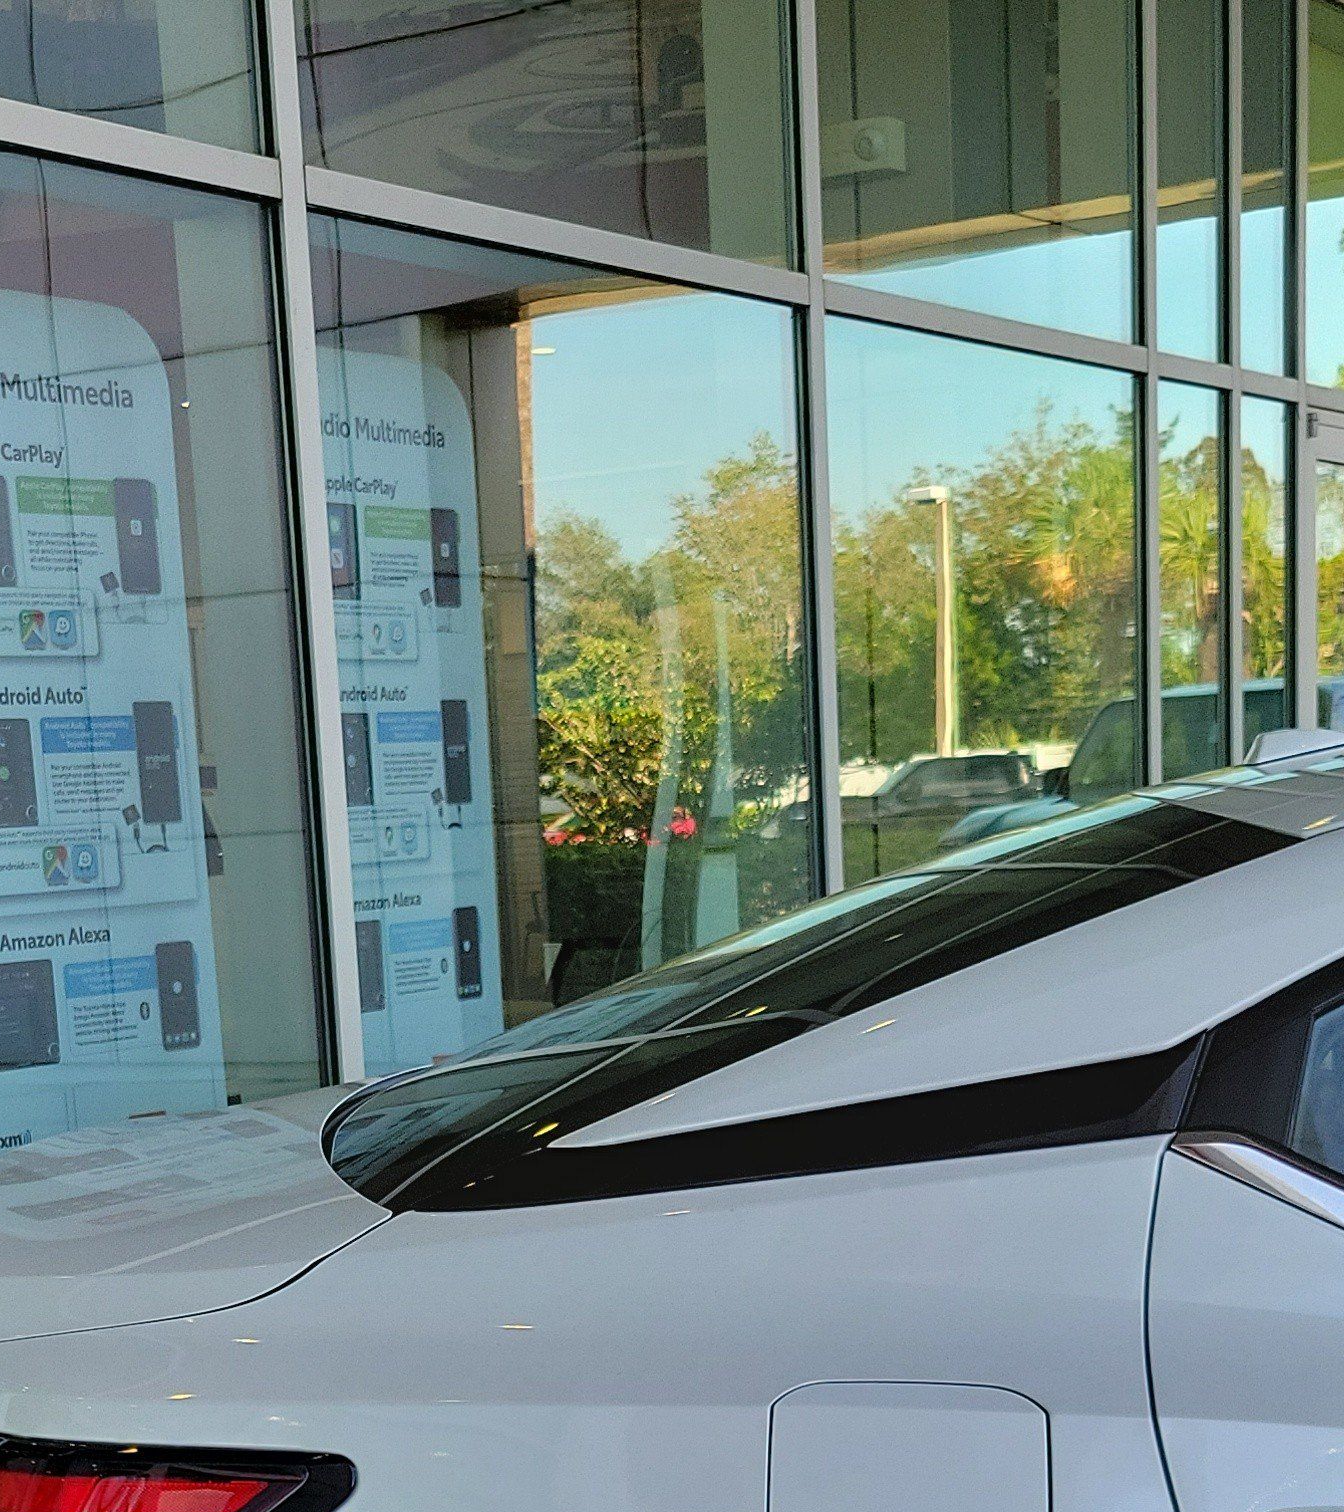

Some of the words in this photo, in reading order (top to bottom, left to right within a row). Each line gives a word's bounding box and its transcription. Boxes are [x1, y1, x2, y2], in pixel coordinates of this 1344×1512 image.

[0, 371, 134, 408] Multimedia
[321, 412, 351, 438] dio
[355, 417, 445, 448] Multimedia
[326, 476, 352, 494] pple
[340, 685, 378, 702] ndroid
[354, 898, 390, 912] mazon
[393, 891, 422, 908] Alexa
[0, 933, 65, 953] Amazon
[68, 926, 111, 946] Alexa
